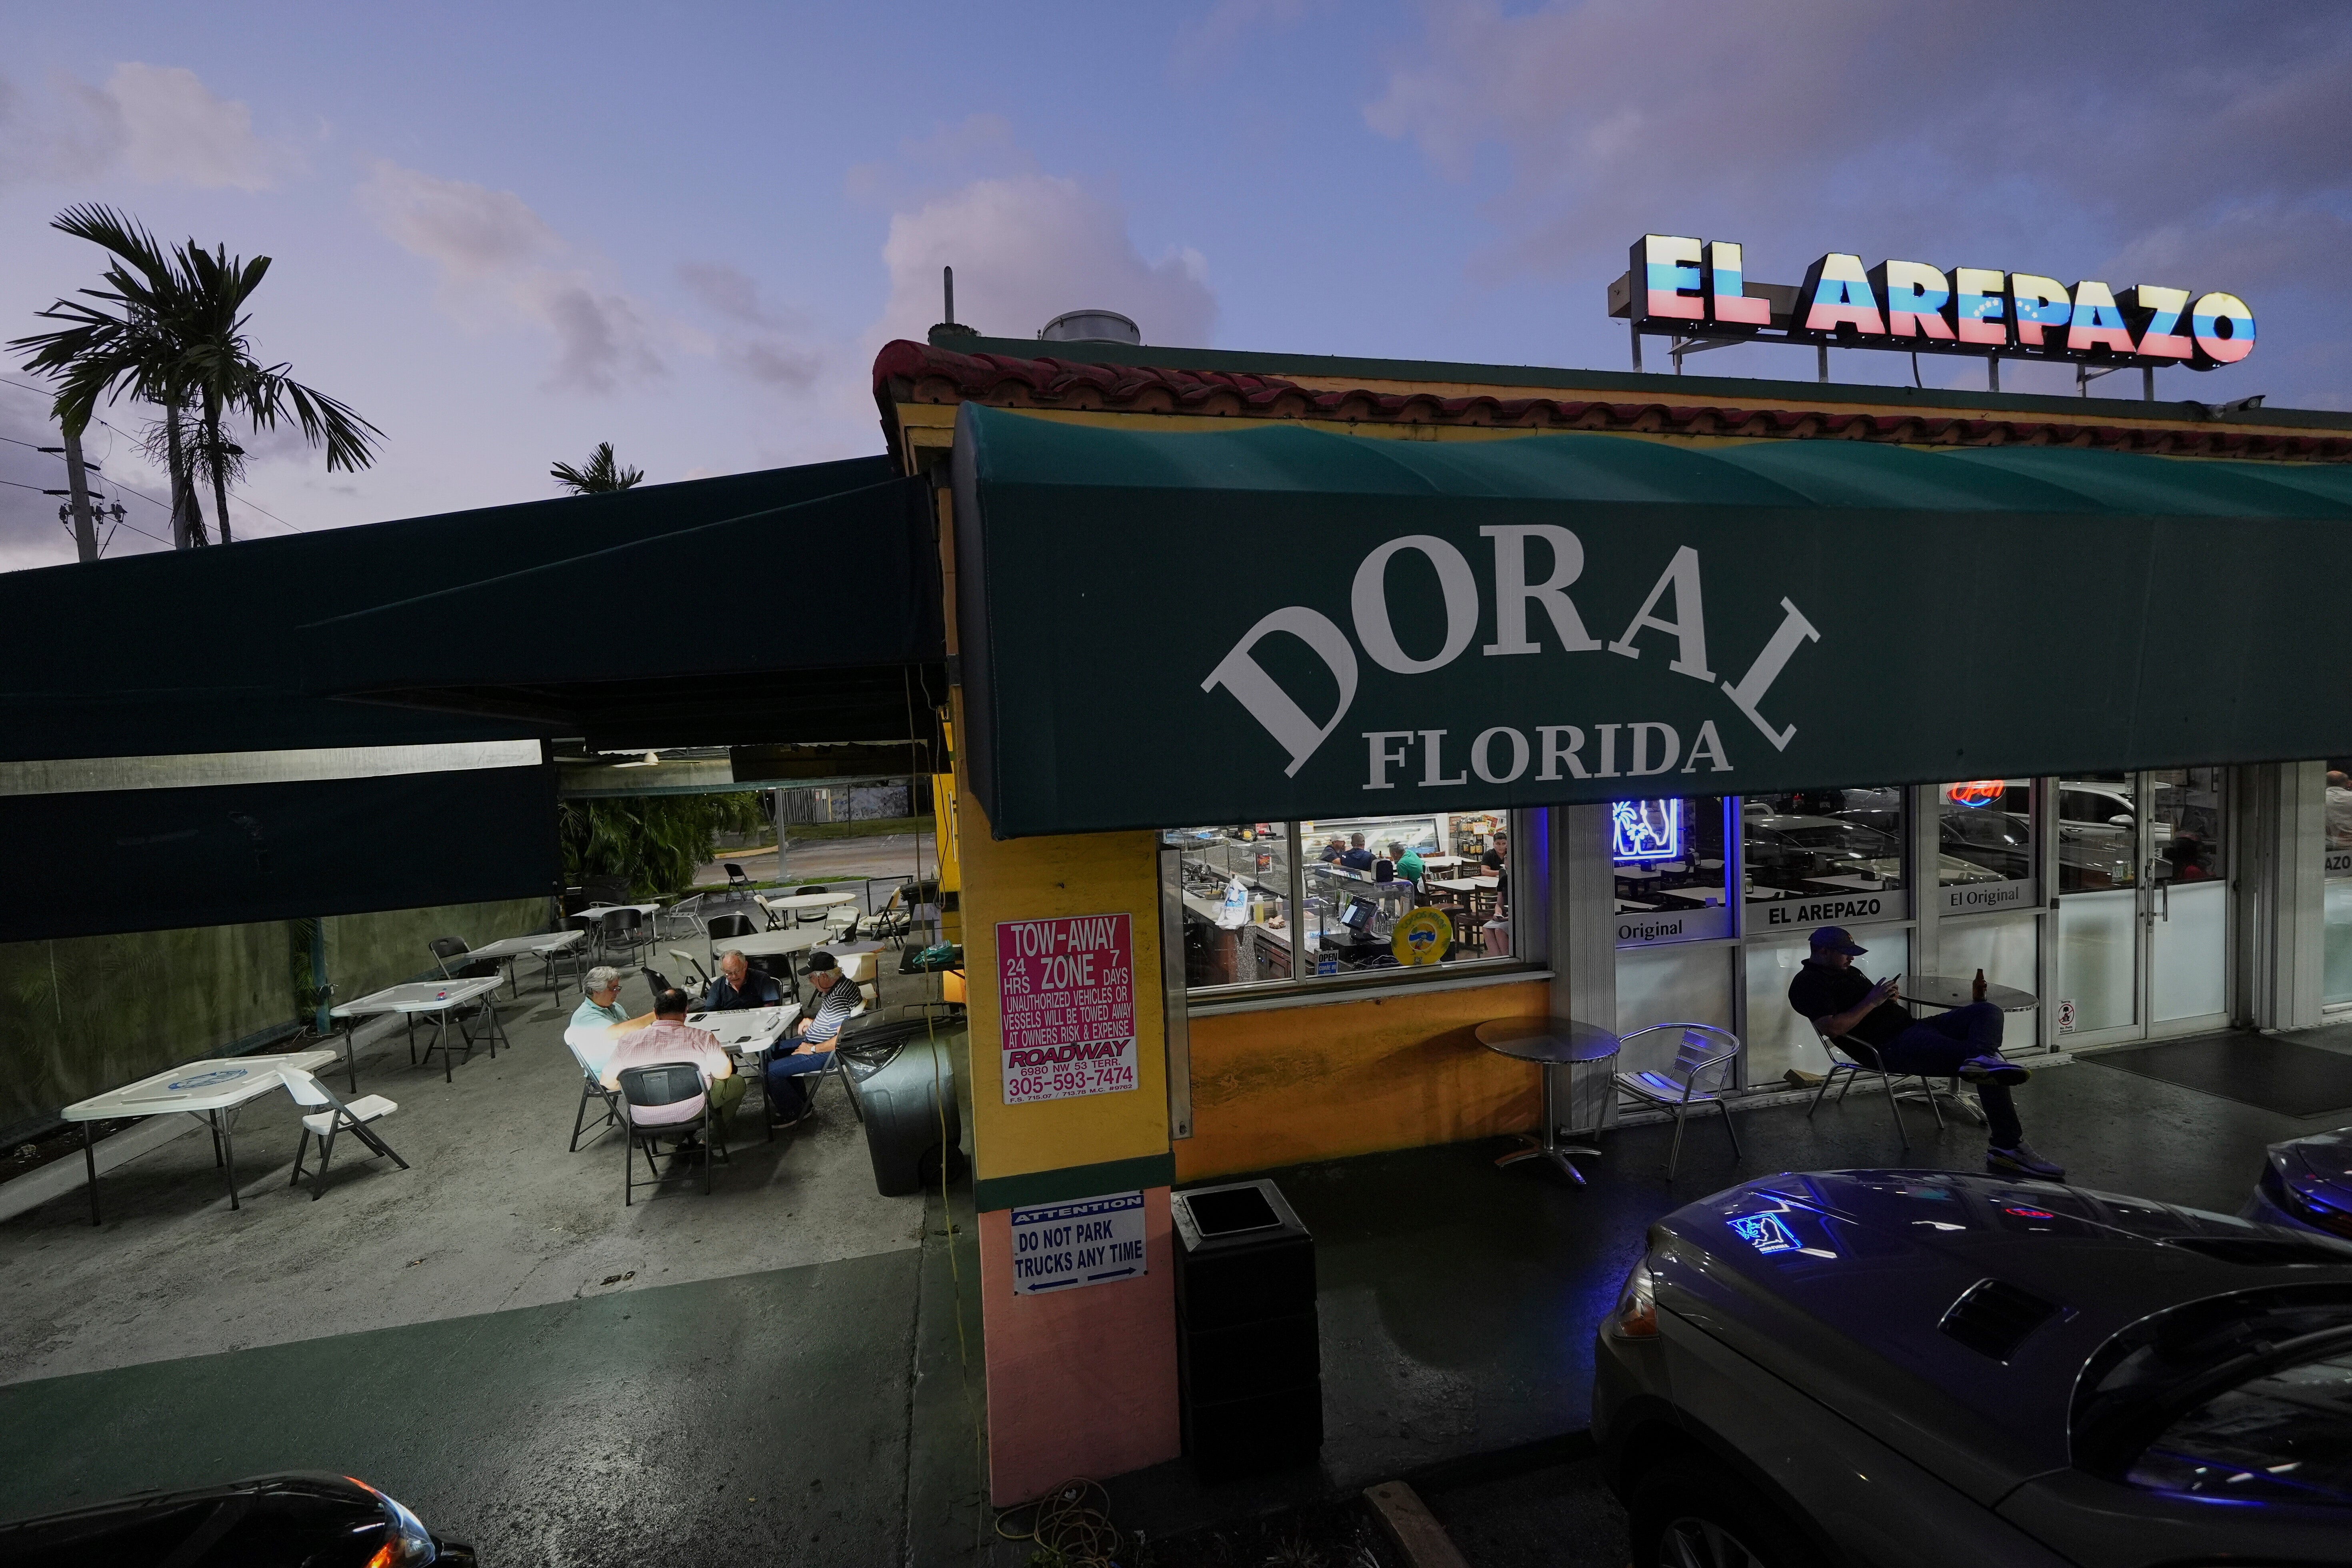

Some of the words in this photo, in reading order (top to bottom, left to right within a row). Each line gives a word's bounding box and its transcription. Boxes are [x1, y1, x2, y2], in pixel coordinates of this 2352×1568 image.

[1645, 233, 1772, 326] EL
[1804, 252, 2256, 364] AREPAZO
[1200, 524, 1821, 778] DORAL
[1361, 719, 1734, 791] FLORIDA
[1951, 892, 1962, 906] El
[1967, 886, 2018, 906] Original
[1769, 908, 1792, 924] EL
[1797, 898, 1881, 922] AREPAZO
[1011, 917, 1117, 957] TOW-AWAY
[1618, 920, 1682, 940] Original
[1007, 958, 1026, 976] 24
[1110, 950, 1120, 966] 7
[1319, 953, 1337, 962] OPEN
[1004, 976, 1030, 995] HRS
[1040, 954, 1095, 990] ZONE
[1103, 967, 1128, 986] DAYS
[1006, 991, 1070, 1013] UNAUTHORIZED
[1073, 986, 1112, 1006] VEHICLES
[1116, 986, 1128, 1002] OR
[1003, 1011, 1041, 1030] VESSELS
[1044, 1009, 1063, 1026] WILL
[1066, 1008, 1077, 1024] BE
[1080, 1004, 1109, 1023] TOWED
[1112, 1002, 1131, 1020] AWAY
[1008, 1032, 1018, 1048] AT
[1022, 1027, 1058, 1047] OWNERS
[1061, 1025, 1080, 1043] RISK
[1084, 1024, 1089, 1040] &
[1092, 1020, 1129, 1039] EXPENSE
[1008, 1039, 1131, 1069] ROADWAY
[1021, 1066, 1048, 1076] 6980
[1053, 1063, 1070, 1072] NW
[1075, 1062, 1087, 1070] 53
[1092, 1058, 1121, 1068] TERR.
[1009, 1066, 1133, 1096] 305-593-7474
[1014, 1197, 1141, 1223] ATTENTION
[1019, 1231, 1039, 1252] DO
[1043, 1226, 1072, 1249] NOT
[1076, 1220, 1113, 1244] PARK
[1015, 1252, 1073, 1278] TRUCKS
[1077, 1246, 1106, 1269] ANY
[1109, 1240, 1143, 1263] TIME
